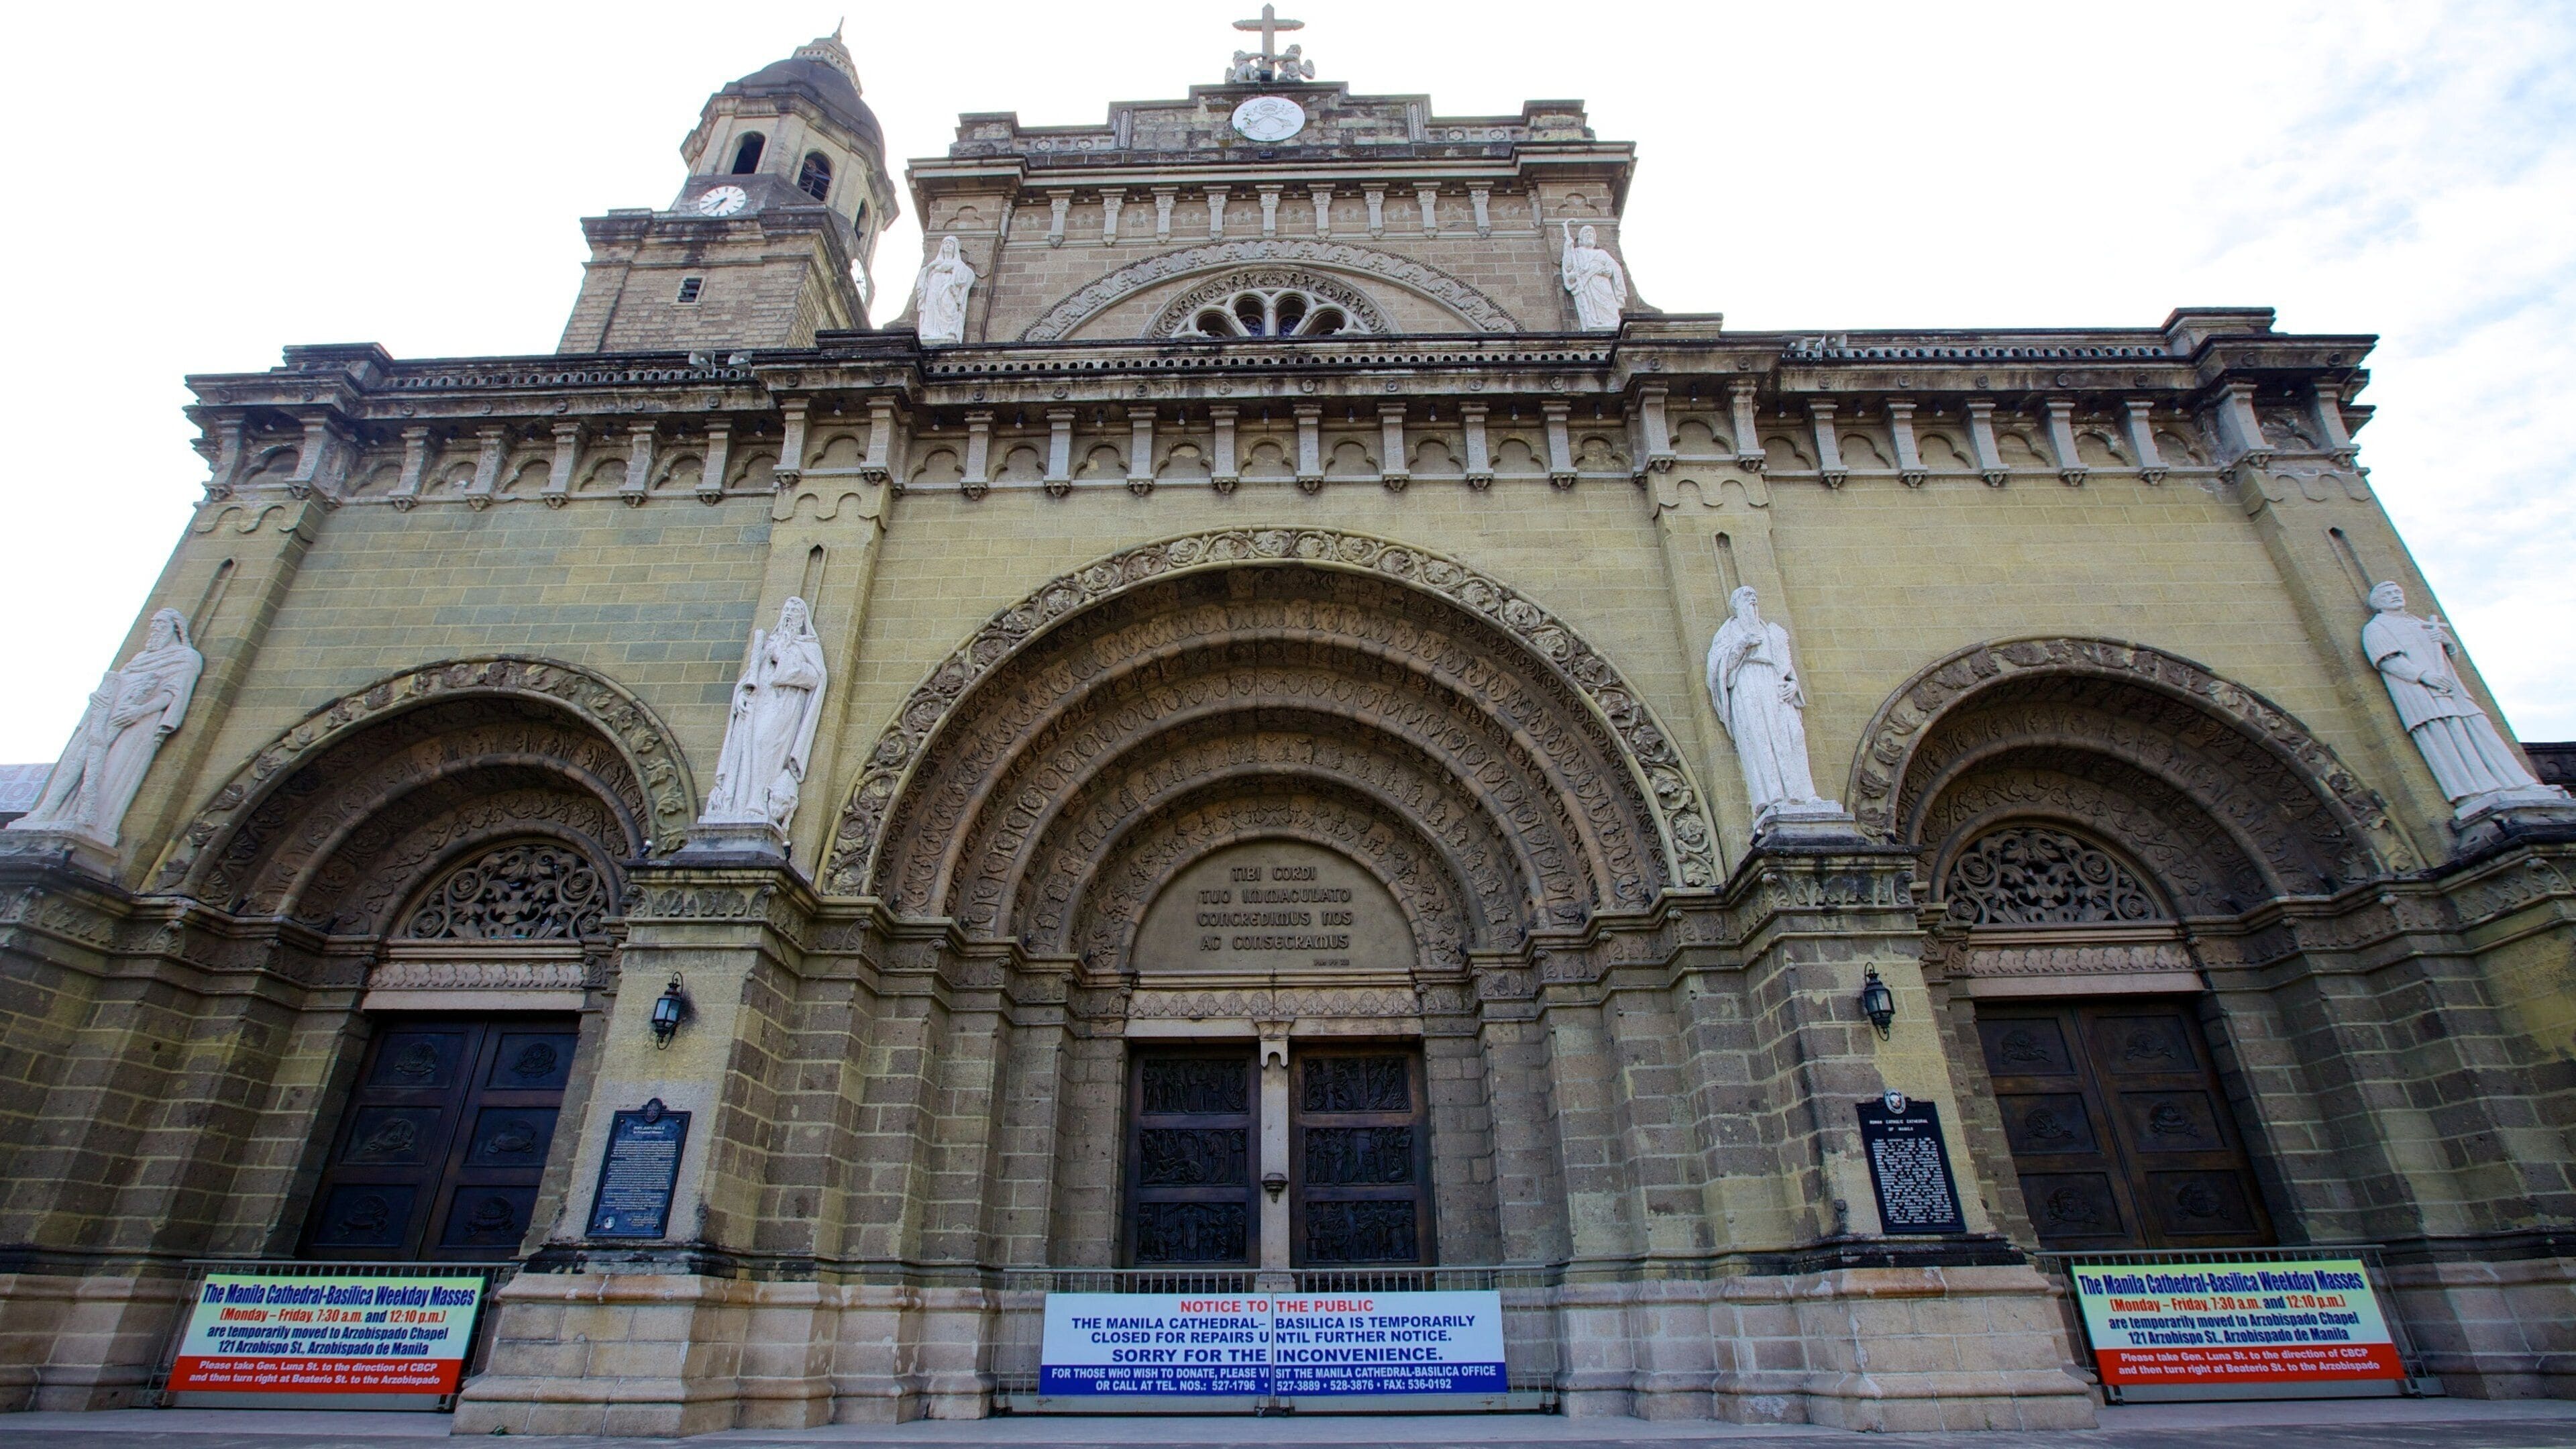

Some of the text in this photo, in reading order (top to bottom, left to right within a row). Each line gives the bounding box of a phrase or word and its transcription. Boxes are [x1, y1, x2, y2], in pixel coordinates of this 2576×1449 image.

[1232, 867, 1317, 881] TIBI CORDI
[1199, 889, 1352, 904] TUO IMMACULATO
[1197, 911, 1353, 926] CONCREDIMUS NOS
[1200, 935, 1349, 951] AC CONSECRAMUS
[2078, 1271, 2364, 1295] The Manila Cathedral-Basilica Weekday Masses
[203, 1283, 475, 1307] The Manila Cathedral-Basilica Weekday Masses
[1180, 1300, 1374, 1312] NOTICE TO THE PUBLIC
[2110, 1298, 2161, 1312] (Monday
[2171, 1298, 2210, 1311] Friday,
[2210, 1296, 2235, 1311] 7:30
[2237, 1297, 2261, 1309] a.m.
[2263, 1296, 2286, 1309] and
[2286, 1295, 2316, 1308] 12:10
[2316, 1294, 2347, 1309] p.m.)
[220, 1308, 268, 1322] (Monday
[278, 1309, 314, 1323] Friday,
[317, 1309, 339, 1322] 7:30
[341, 1311, 362, 1322] a.m.
[365, 1310, 388, 1322] and
[390, 1310, 417, 1322] 12:10
[418, 1310, 446, 1324] p.m.)
[1072, 1318, 1101, 1329] THE
[1107, 1318, 1164, 1329] MANILA
[1275, 1318, 1344, 1329] BASILICA
[1350, 1318, 1364, 1328] IS
[1368, 1316, 1475, 1328] TEMPORARILY
[2109, 1311, 2360, 1330] are temporarily moved to Arzobispado Chapel
[207, 1326, 449, 1340] are temporarily moved to Arzobispado Chapel
[1091, 1332, 1150, 1343] CLOSED
[1156, 1332, 1185, 1342] FOR
[1190, 1332, 1254, 1342] REPAIRS
[1315, 1330, 1385, 1342] FURTHER
[1391, 1330, 1452, 1342] NOTICE.
[2128, 1332, 2147, 1344] 121
[2148, 1331, 2203, 1345] Arzobispo
[2223, 1329, 2293, 1344] Arzobispado
[2294, 1328, 2309, 1341] de
[2310, 1328, 2350, 1341] Manila
[218, 1340, 234, 1352] 121
[235, 1340, 288, 1354] Arzobispo
[307, 1342, 374, 1356] Arzobispado
[376, 1343, 390, 1354] de
[391, 1342, 429, 1355] Manila
[1112, 1348, 1443, 1362] SORRY FOR THE INCONVENIENCE.
[2120, 1353, 2154, 1362] Please
[2156, 1353, 2179, 1361] take
[2181, 1352, 2204, 1361] Gen.
[2206, 1352, 2231, 1360] Luna
[2235, 1352, 2247, 1360] St.
[2263, 1351, 2279, 1359] the
[2282, 1350, 2326, 1359] direction
[2328, 1348, 2338, 1358] of
[2341, 1348, 2368, 1358] CBCP
[199, 1360, 231, 1369] Please
[233, 1361, 254, 1370] take
[256, 1362, 277, 1370] Gen.
[280, 1362, 303, 1371] Luna
[306, 1362, 319, 1371] St.
[335, 1363, 350, 1371] the
[352, 1363, 394, 1372] direction
[397, 1363, 408, 1372] of
[410, 1363, 437, 1372] CBCP
[1052, 1368, 1071, 1378] FOR
[1074, 1368, 1106, 1378] THOSE
[1108, 1368, 1130, 1378] WHO
[1133, 1368, 1158, 1378] WISH
[1161, 1368, 1174, 1378] TO
[1176, 1368, 1218, 1380] DONATE,
[1220, 1368, 1256, 1378] PLEASE
[1294, 1368, 1313, 1378] THE
[1316, 1367, 1352, 1378] MANILA
[1356, 1366, 1459, 1377] CATHEDRAL-BASILICA
[1462, 1366, 1496, 1376] OFFICE
[2119, 1366, 2137, 1374] and
[2139, 1365, 2162, 1374] then
[2164, 1365, 2185, 1374] turn
[2188, 1364, 2211, 1375] right
[2214, 1365, 2224, 1373] at
[2226, 1363, 2269, 1373] Beaterio
[2270, 1362, 2286, 1372] St.
[2300, 1362, 2316, 1371] the
[2319, 1361, 2380, 1371] Arzobispado
[189, 1373, 208, 1381] and
[209, 1373, 230, 1382] then
[233, 1374, 252, 1382] turn
[255, 1374, 277, 1385] right
[291, 1375, 332, 1383] Beaterio
[335, 1375, 347, 1384] St.
[351, 1376, 360, 1384] to
[363, 1375, 378, 1384] the
[381, 1375, 440, 1385] Arzobispado
[1095, 1379, 1452, 1391] OR CALL AT TEL. NOS.: 527-1796 527-3889 528-3876 FAX: 536-0192
